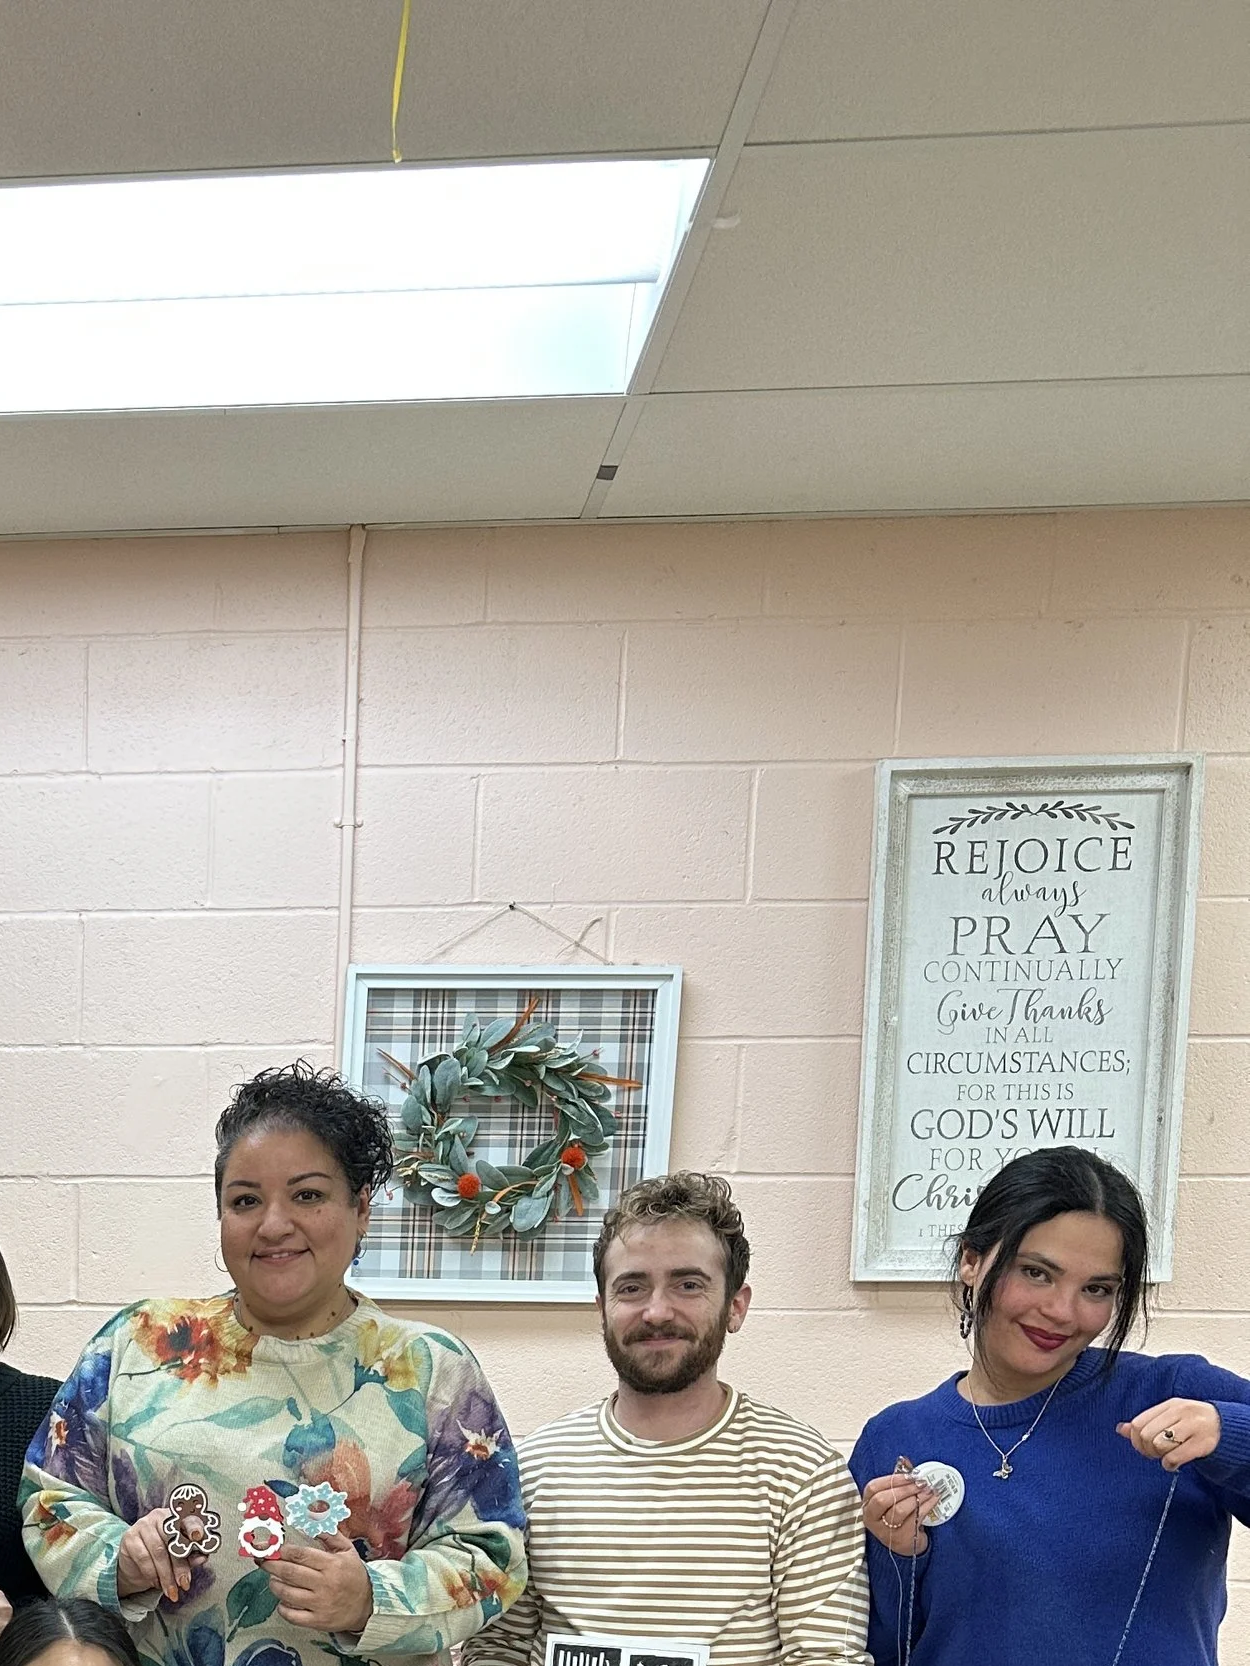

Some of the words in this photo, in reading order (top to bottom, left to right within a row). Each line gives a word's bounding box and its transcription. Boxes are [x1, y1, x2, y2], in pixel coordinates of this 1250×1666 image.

[932, 837, 1133, 880] REJOICE
[982, 870, 1087, 918] always
[946, 913, 1111, 956] PRAY
[923, 958, 1124, 983] CONTINUALLY
[937, 989, 1004, 1036] Give
[997, 986, 1113, 1026] Thanks
[985, 1026, 1008, 1044] IN
[1014, 1026, 1054, 1043] ALL
[907, 1050, 1131, 1075] CIRCUMSTANCES;
[957, 1084, 996, 1101] FOR
[1003, 1083, 1051, 1100] THIS
[1057, 1083, 1074, 1100] IS
[911, 1108, 1019, 1140] GOD'S
[1027, 1107, 1116, 1139] WILL
[928, 1147, 983, 1171] FOR
[892, 1173, 986, 1212] Chri
